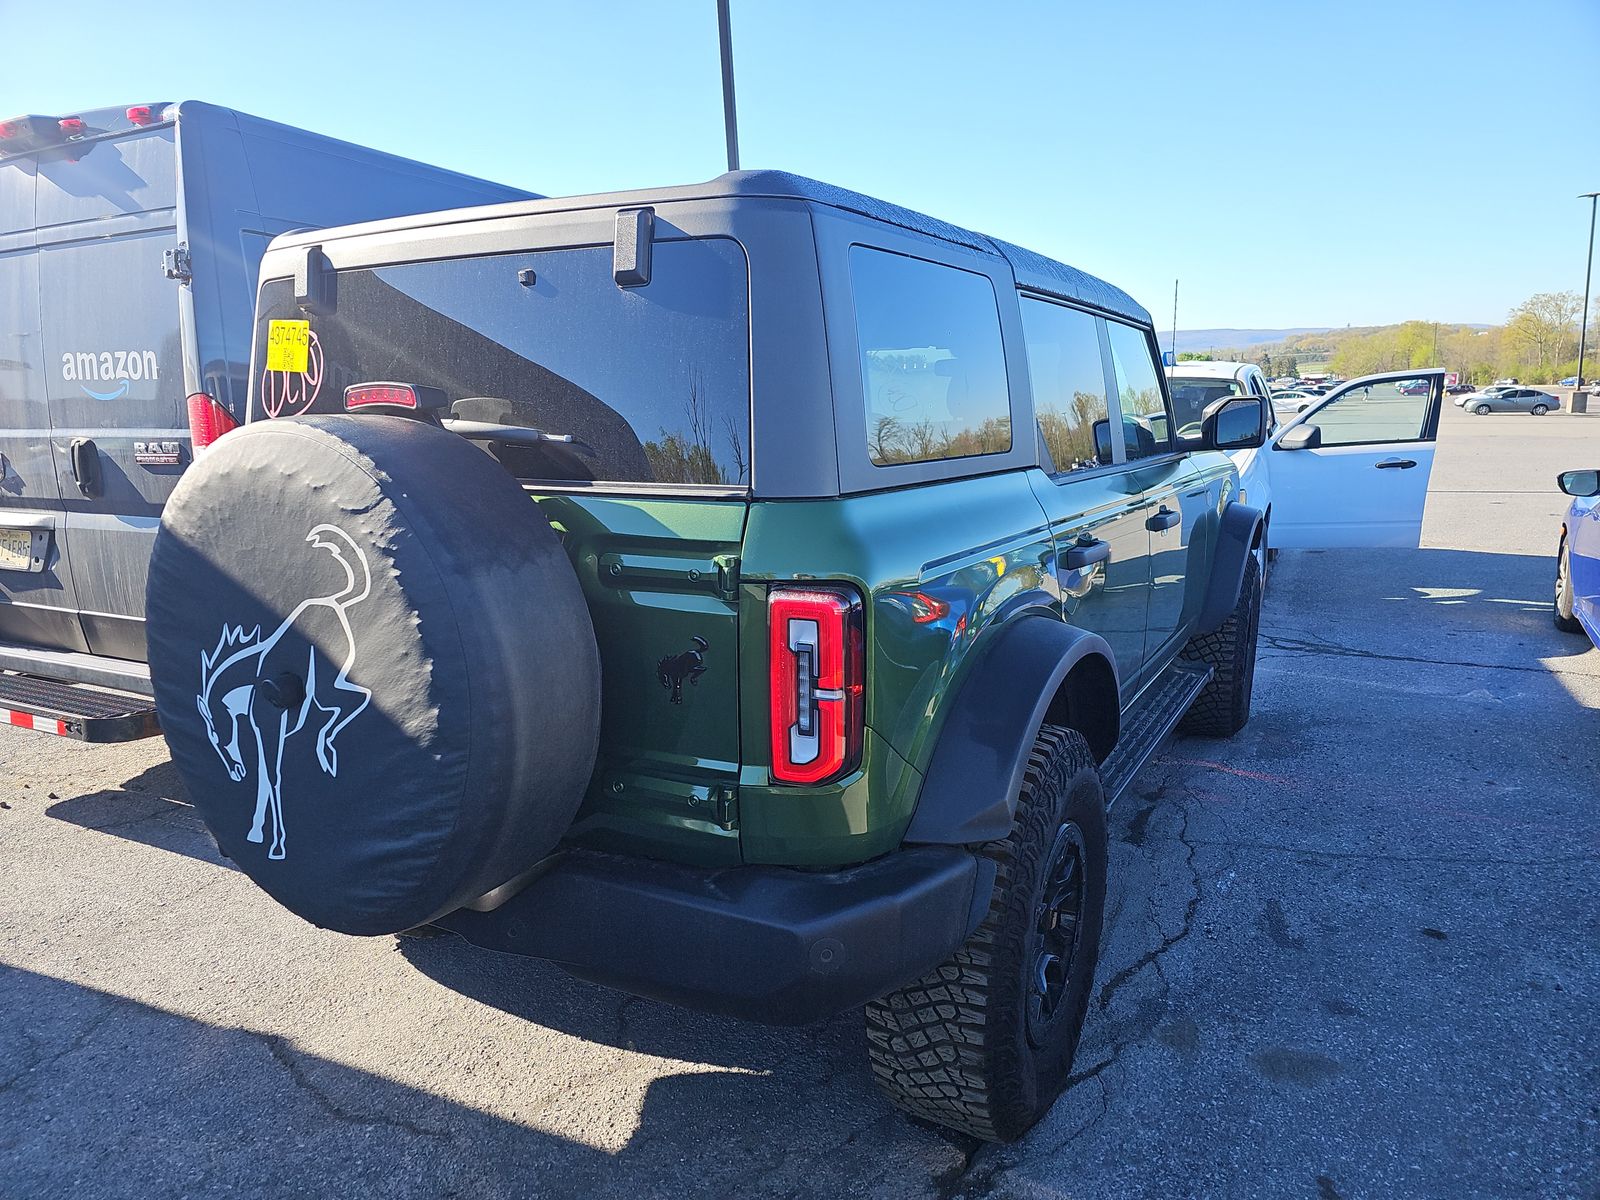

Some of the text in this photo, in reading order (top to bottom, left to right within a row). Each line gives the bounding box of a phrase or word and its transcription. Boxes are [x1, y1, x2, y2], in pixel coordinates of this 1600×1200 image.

[269, 326, 308, 346] 4374745
[62, 350, 158, 380] amazon
[133, 441, 180, 454] RAM
